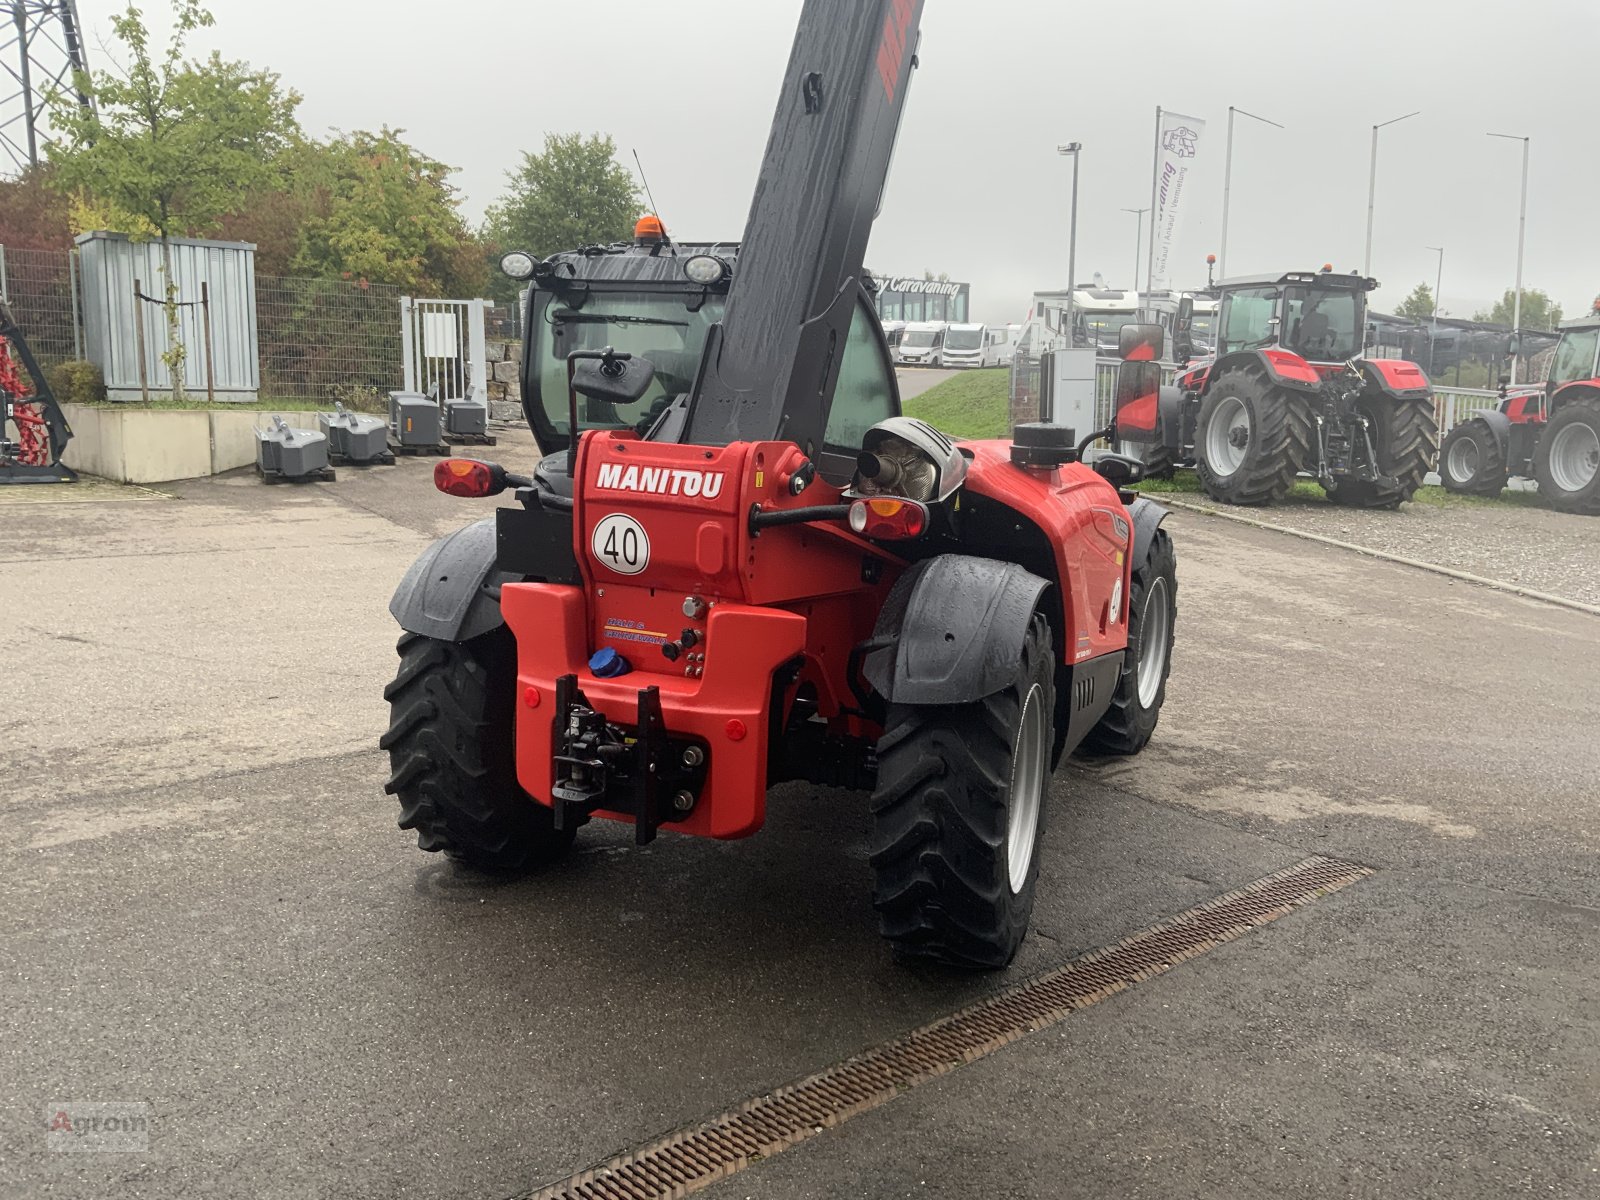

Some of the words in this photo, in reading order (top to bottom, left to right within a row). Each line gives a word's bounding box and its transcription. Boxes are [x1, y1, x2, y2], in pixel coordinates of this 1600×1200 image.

[1171, 166, 1188, 209] Vermietung
[890, 276, 960, 300] Caravaning
[596, 463, 724, 498] MANITOU
[603, 525, 638, 566] 40
